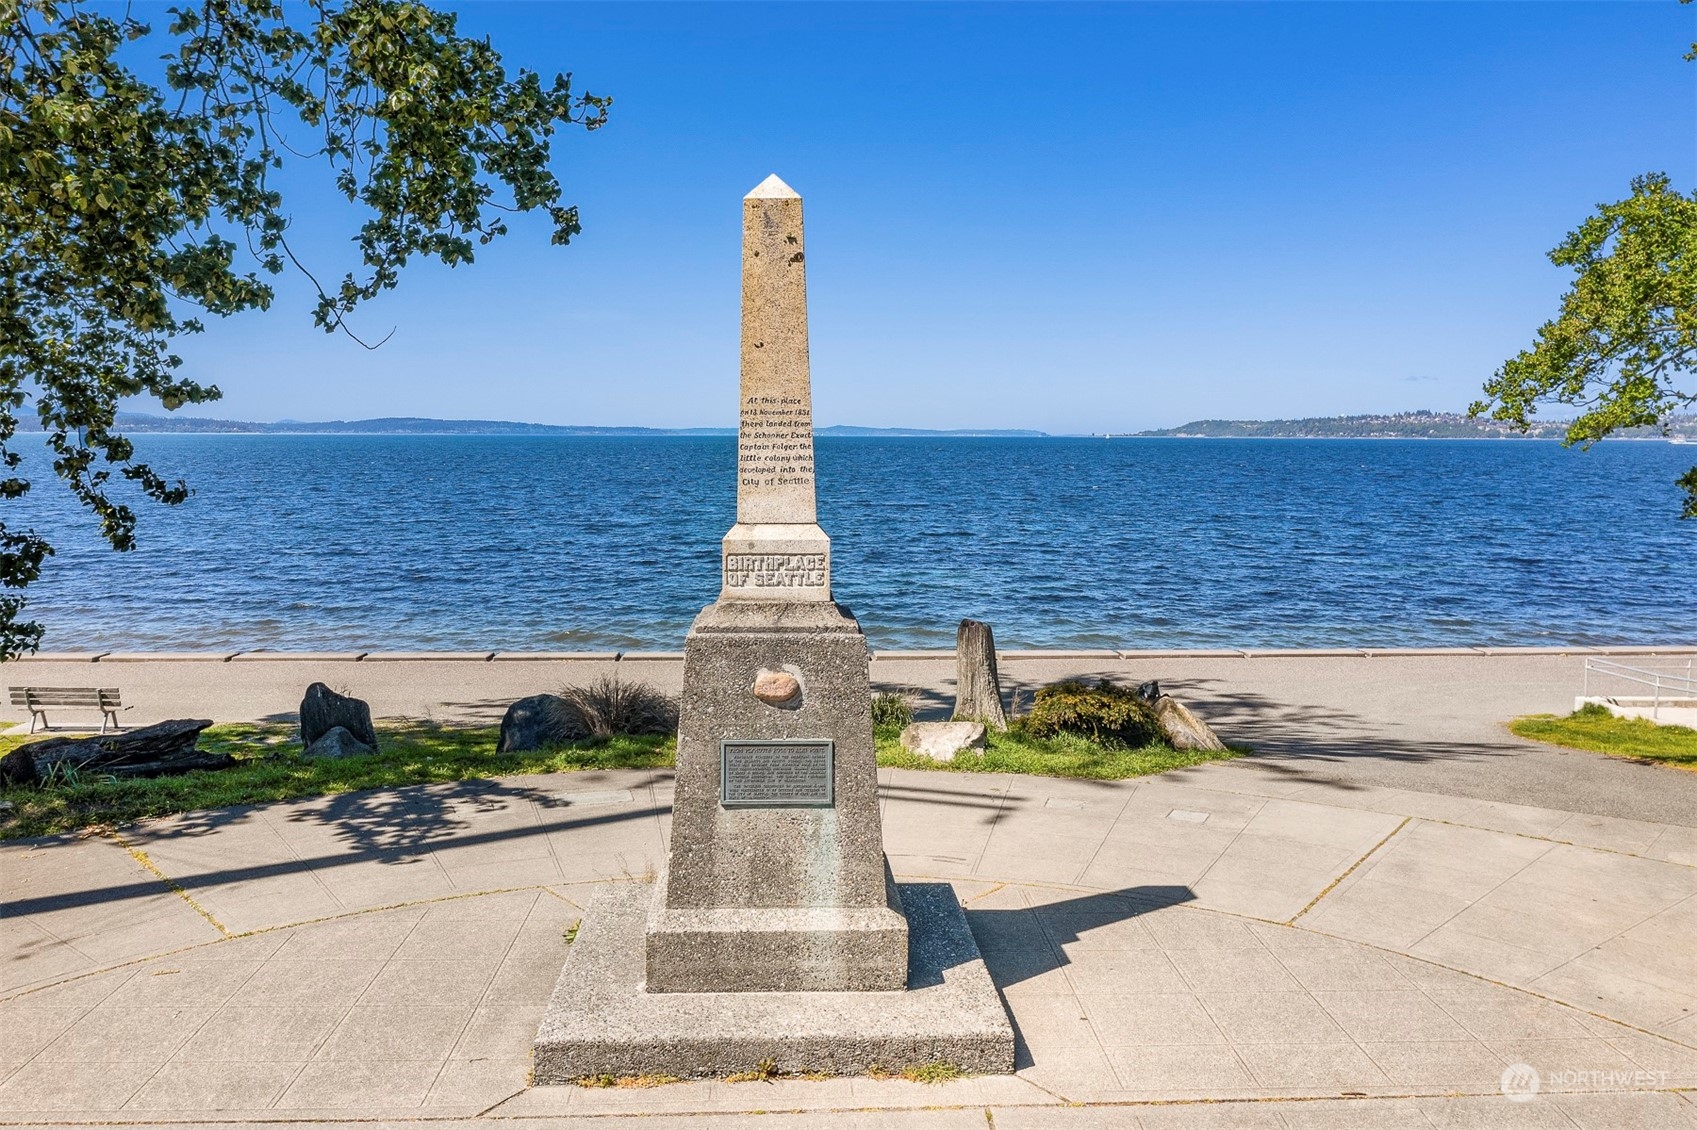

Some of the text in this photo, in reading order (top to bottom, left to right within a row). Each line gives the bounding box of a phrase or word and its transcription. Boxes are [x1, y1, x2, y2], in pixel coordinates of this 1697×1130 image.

[780, 397, 801, 405] place
[739, 466, 776, 474] developed
[743, 478, 760, 487] City
[777, 477, 810, 485] Seattle
[728, 555, 826, 572] BIRTHPLACE
[729, 573, 825, 587] OF SEATTLE
